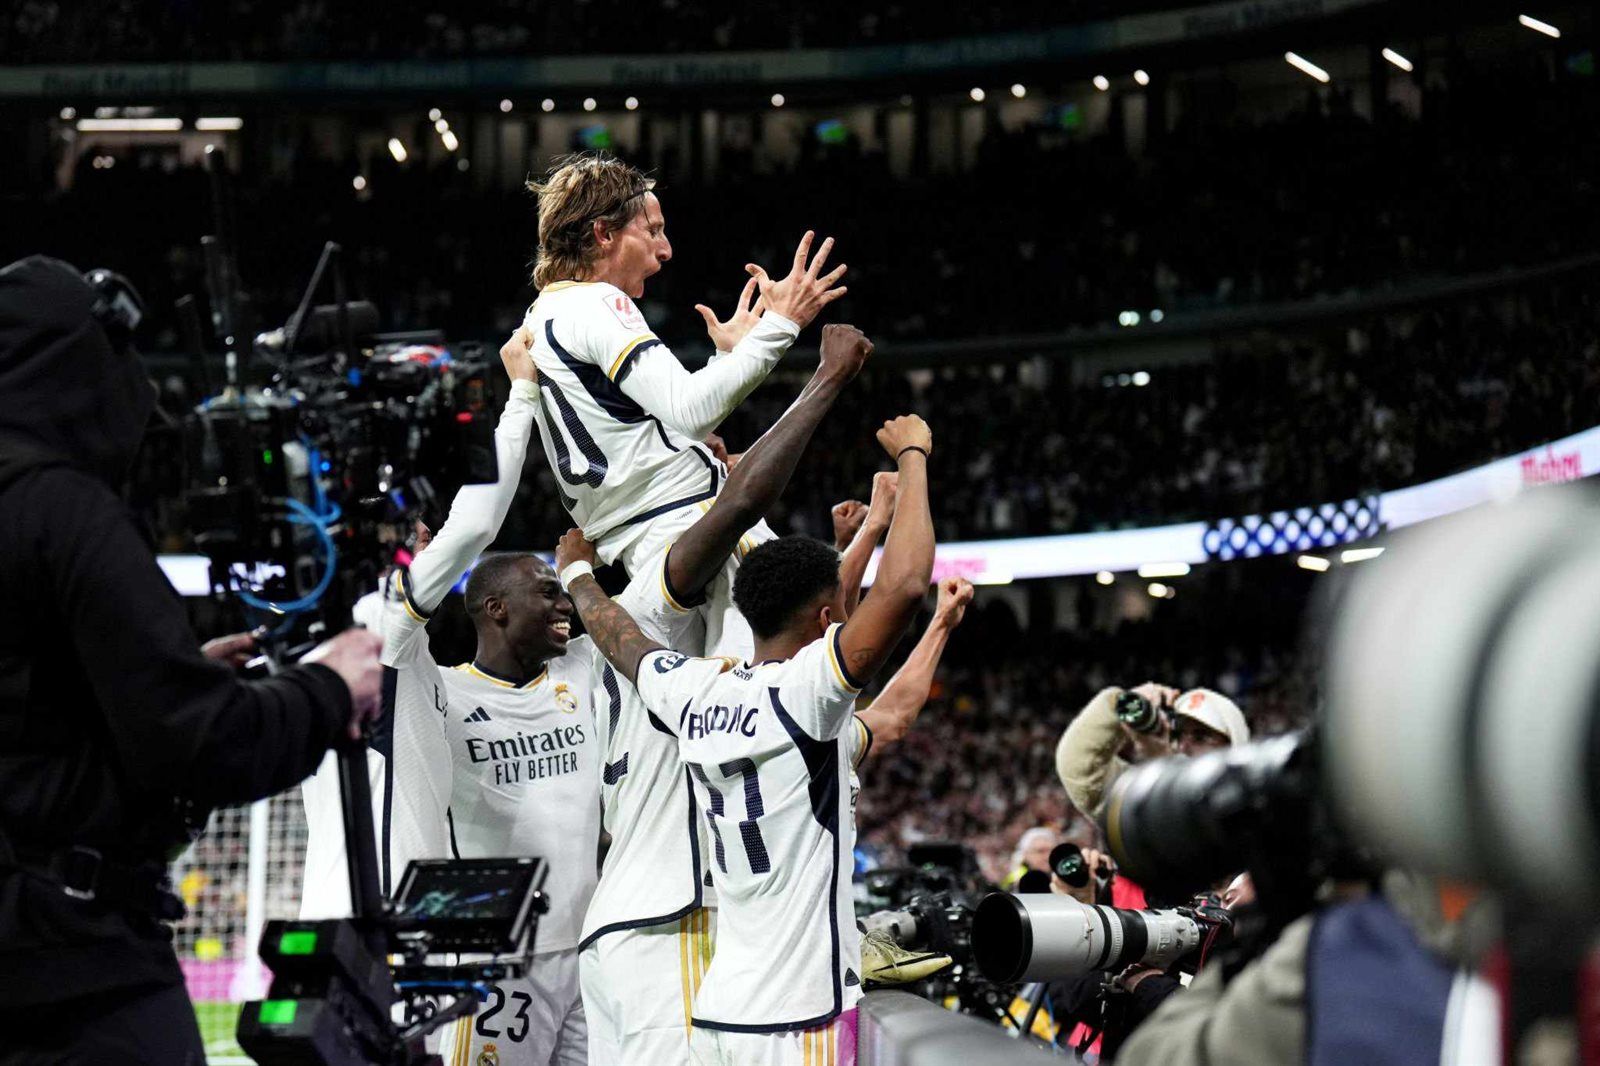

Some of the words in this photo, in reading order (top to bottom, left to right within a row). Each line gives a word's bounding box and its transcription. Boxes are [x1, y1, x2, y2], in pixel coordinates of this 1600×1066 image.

[466, 724, 585, 764] Emirates
[495, 761, 520, 785] FLY
[529, 751, 578, 780] BETTER
[475, 985, 533, 1043] 23
